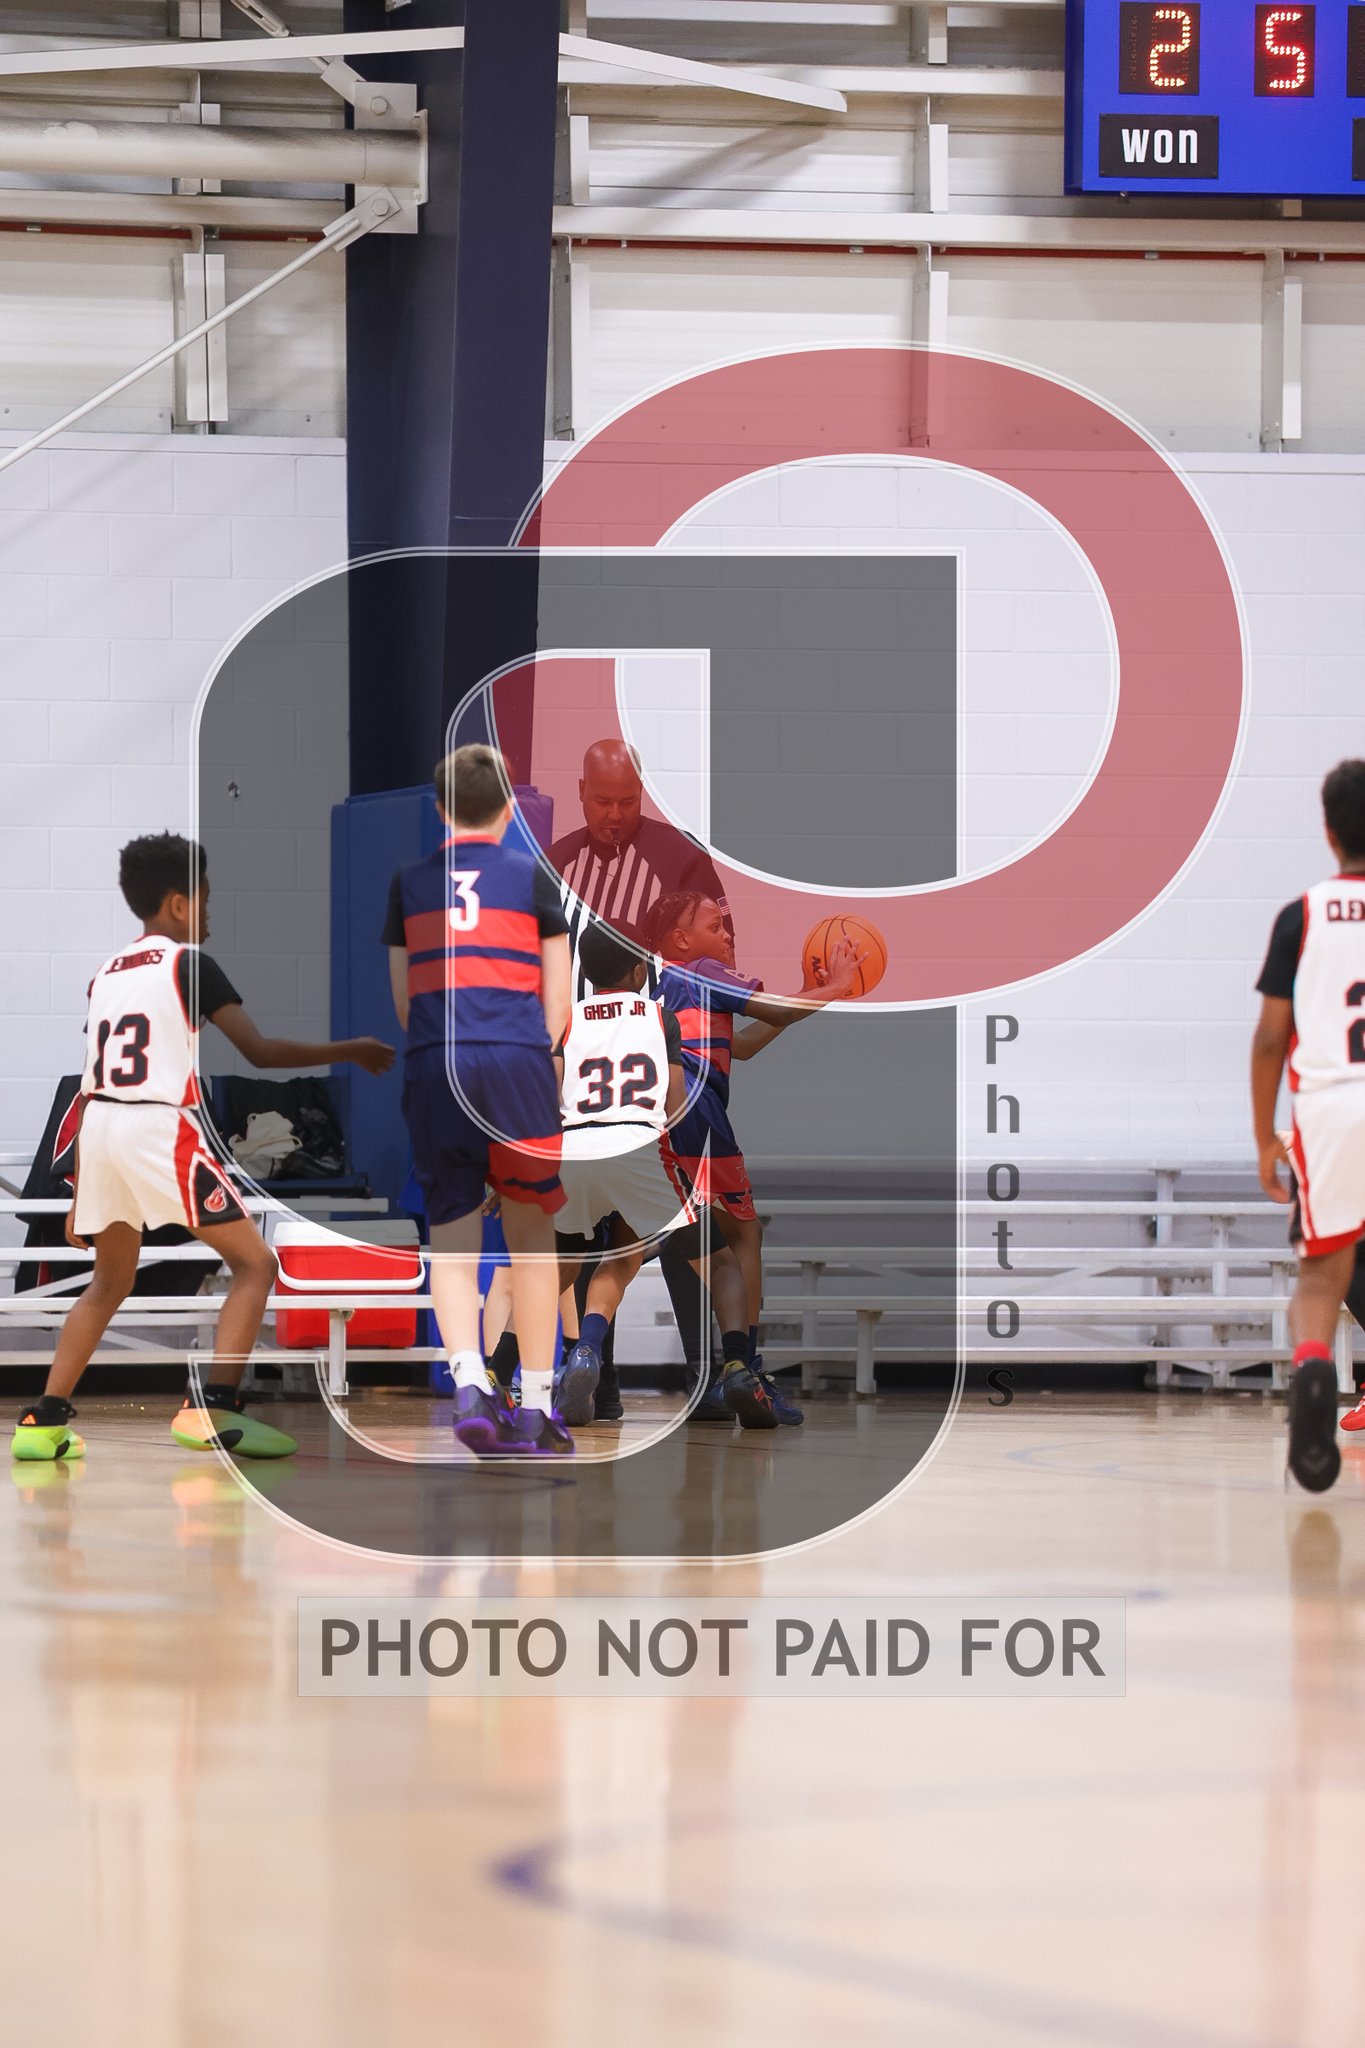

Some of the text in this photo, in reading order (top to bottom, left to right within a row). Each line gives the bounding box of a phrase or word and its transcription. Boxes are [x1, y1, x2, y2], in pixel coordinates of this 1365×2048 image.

[1149, 9, 1191, 87] 2
[1265, 11, 1306, 89] 5
[449, 869, 482, 932] 3
[1326, 898, 1365, 922] CLE
[583, 1000, 647, 1021] GHENT JR
[94, 1013, 151, 1090] 13
[577, 1052, 658, 1114] 32
